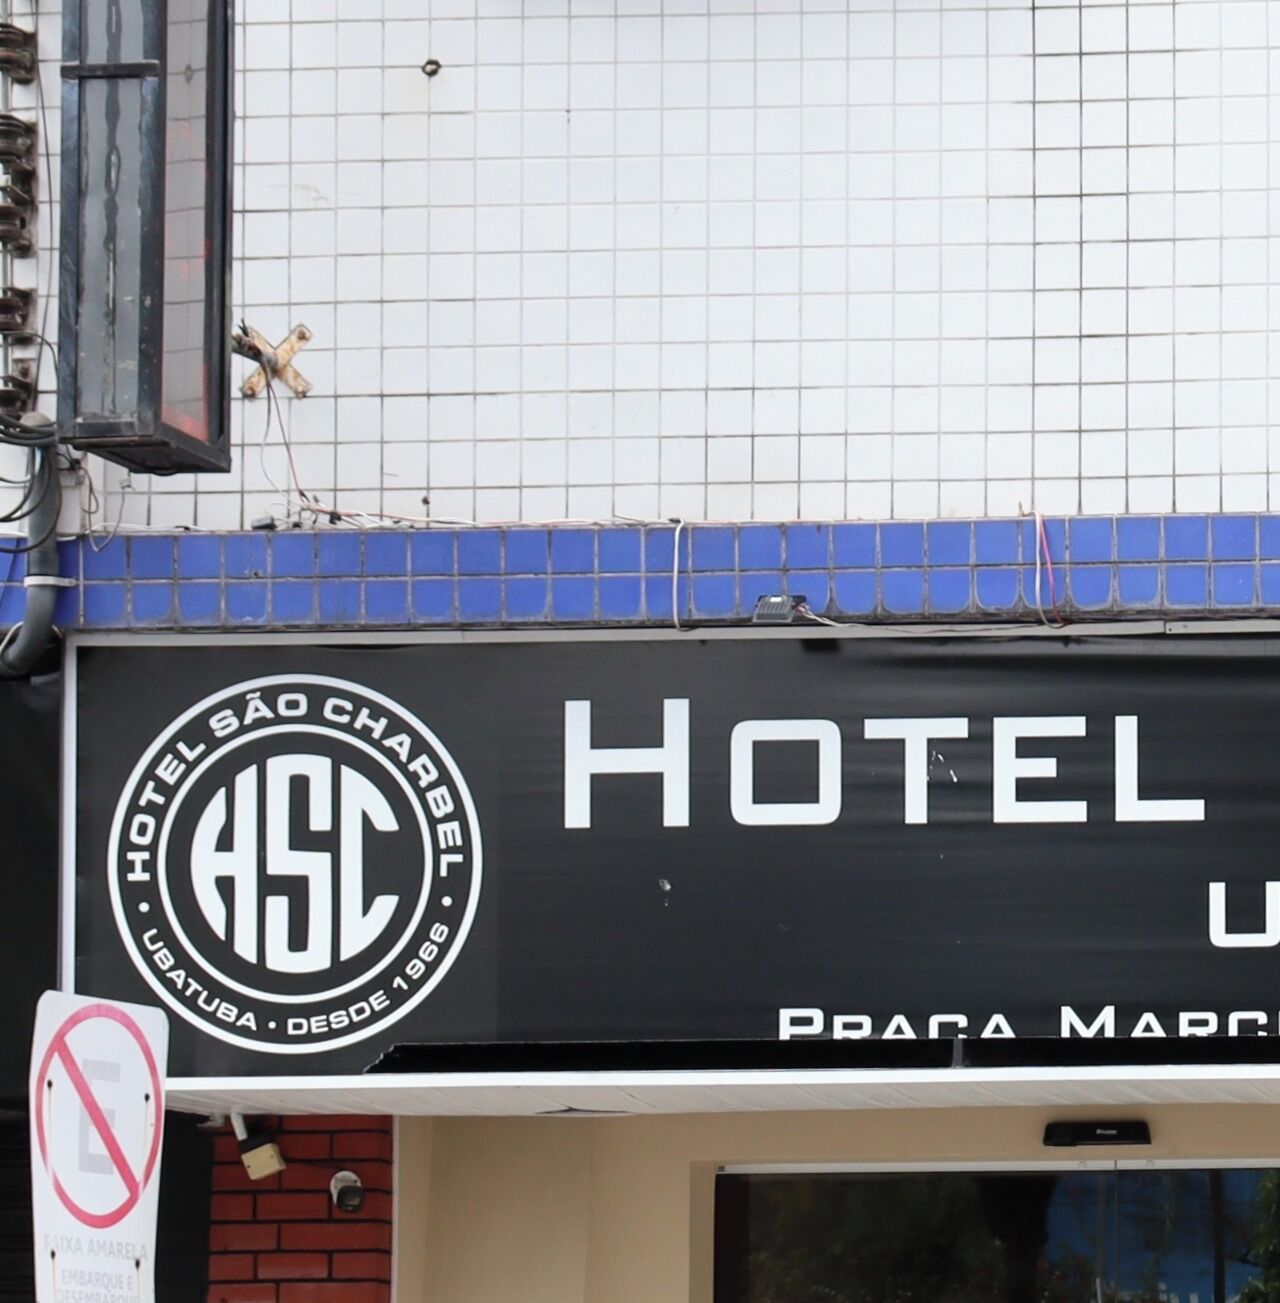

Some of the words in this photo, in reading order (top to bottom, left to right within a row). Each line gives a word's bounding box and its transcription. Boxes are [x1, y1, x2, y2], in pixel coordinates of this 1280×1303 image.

[125, 743, 207, 882] HOTEL
[208, 691, 309, 738] SÃO
[322, 697, 464, 877] CHARBEL
[564, 698, 1205, 829] HOTEL
[190, 753, 400, 974] HSC
[142, 928, 258, 1031] UBATUBA
[287, 990, 390, 1036] DESDE
[393, 922, 449, 991] 1966
[61, 1269, 125, 1292] EMBARQUE
